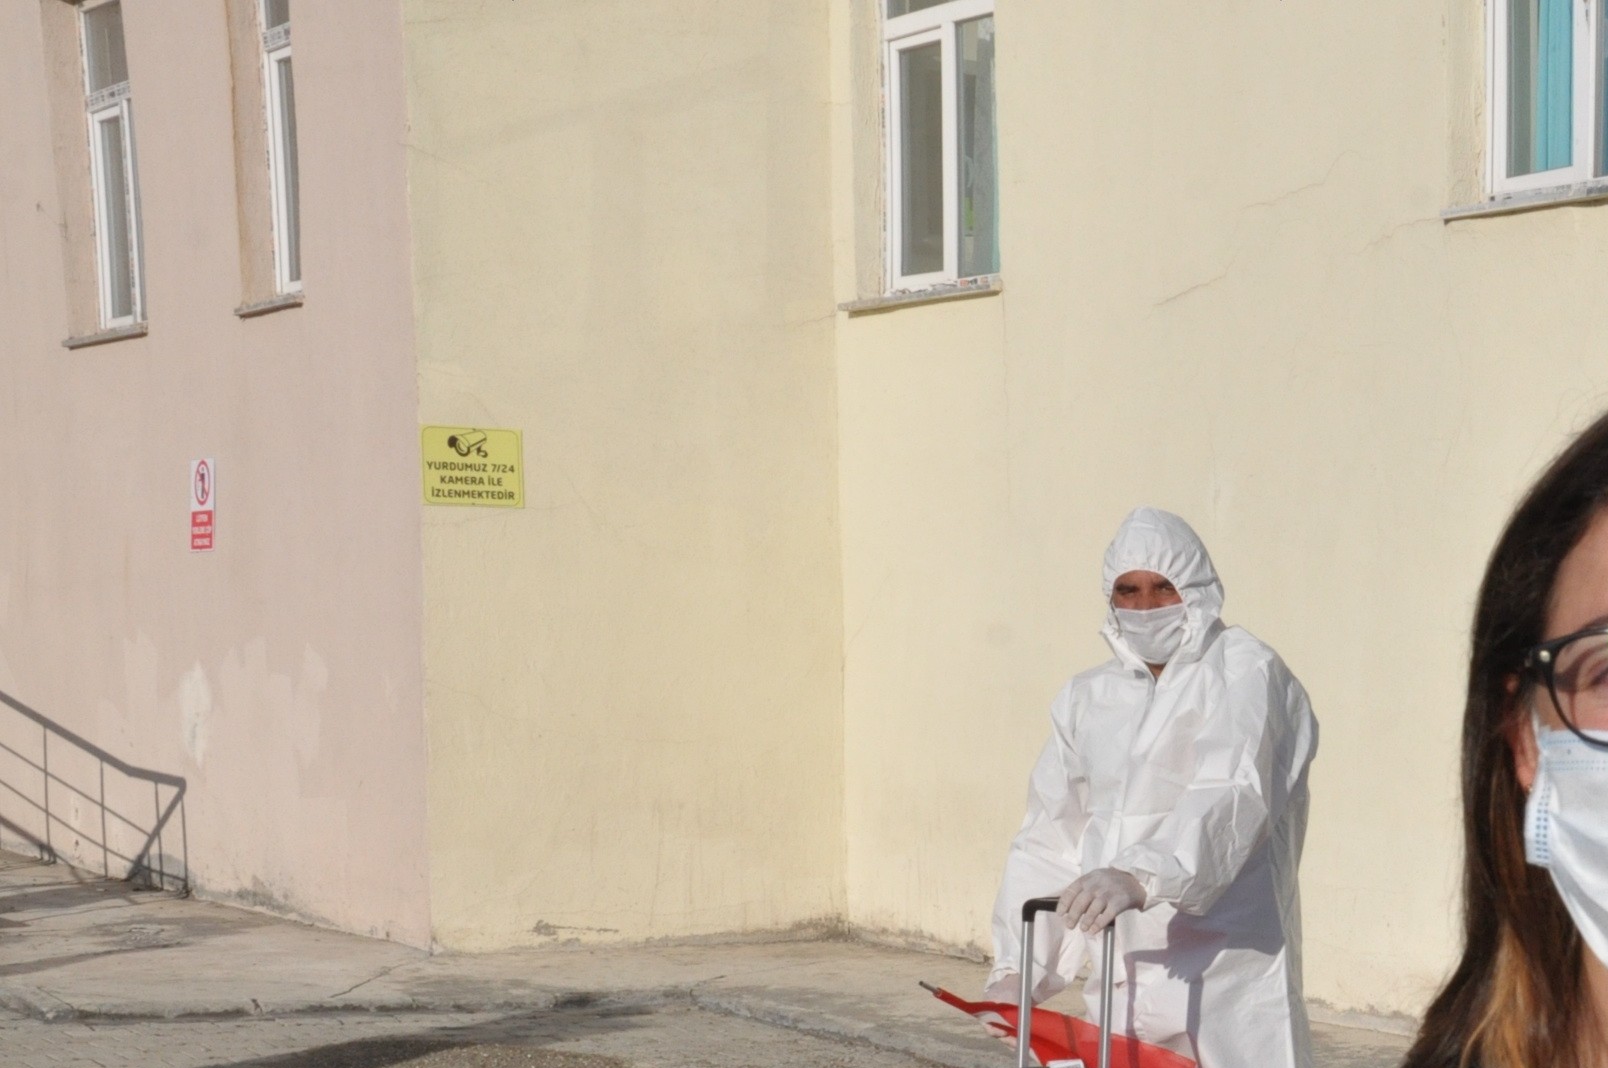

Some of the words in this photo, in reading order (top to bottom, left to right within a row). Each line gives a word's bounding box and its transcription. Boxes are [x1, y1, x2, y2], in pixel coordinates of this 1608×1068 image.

[426, 461, 488, 473] YURDUMUZ
[491, 463, 515, 474] 7/24
[440, 475, 485, 486] KAMERA
[488, 475, 503, 487] İLE
[431, 486, 515, 501] İZLENMEKTEDİR
